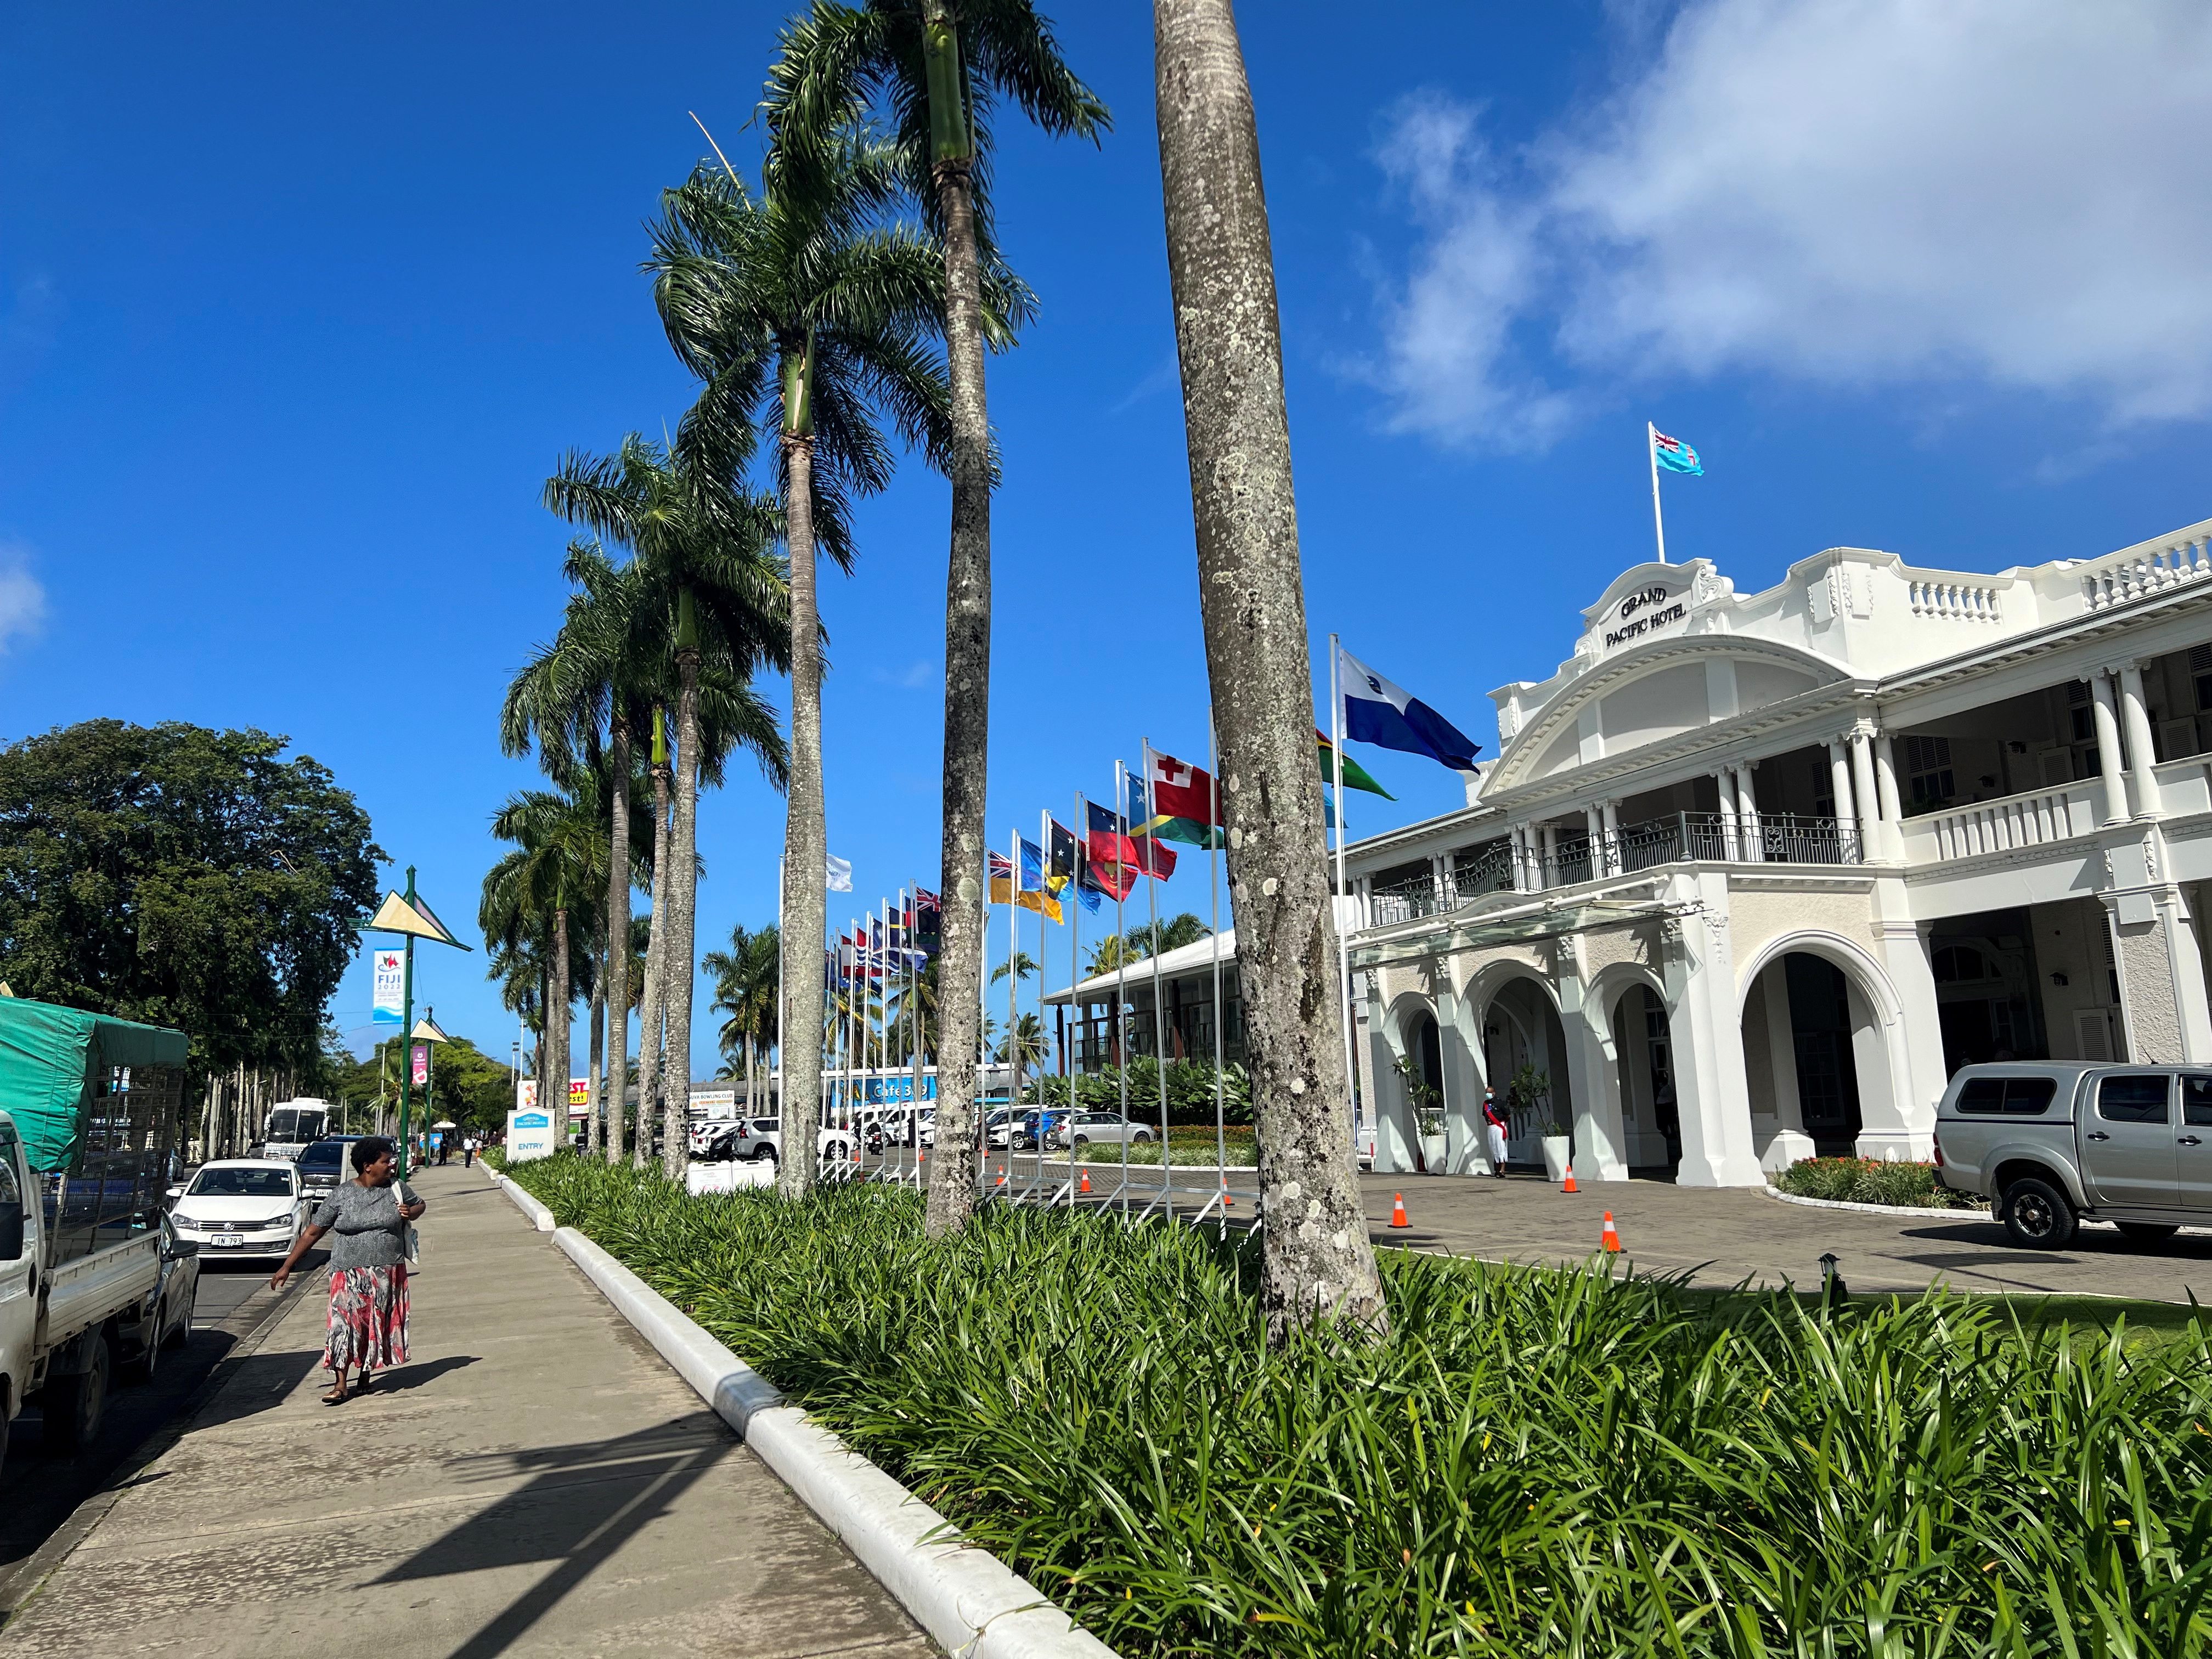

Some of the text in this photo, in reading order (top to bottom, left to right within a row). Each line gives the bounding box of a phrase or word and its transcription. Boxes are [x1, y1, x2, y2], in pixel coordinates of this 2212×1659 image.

[1622, 588, 1667, 617] GRAND
[1606, 603, 1686, 647] PACIFIC HOTEL
[379, 974, 400, 983] FIJI
[905, 1085, 928, 1097] 39
